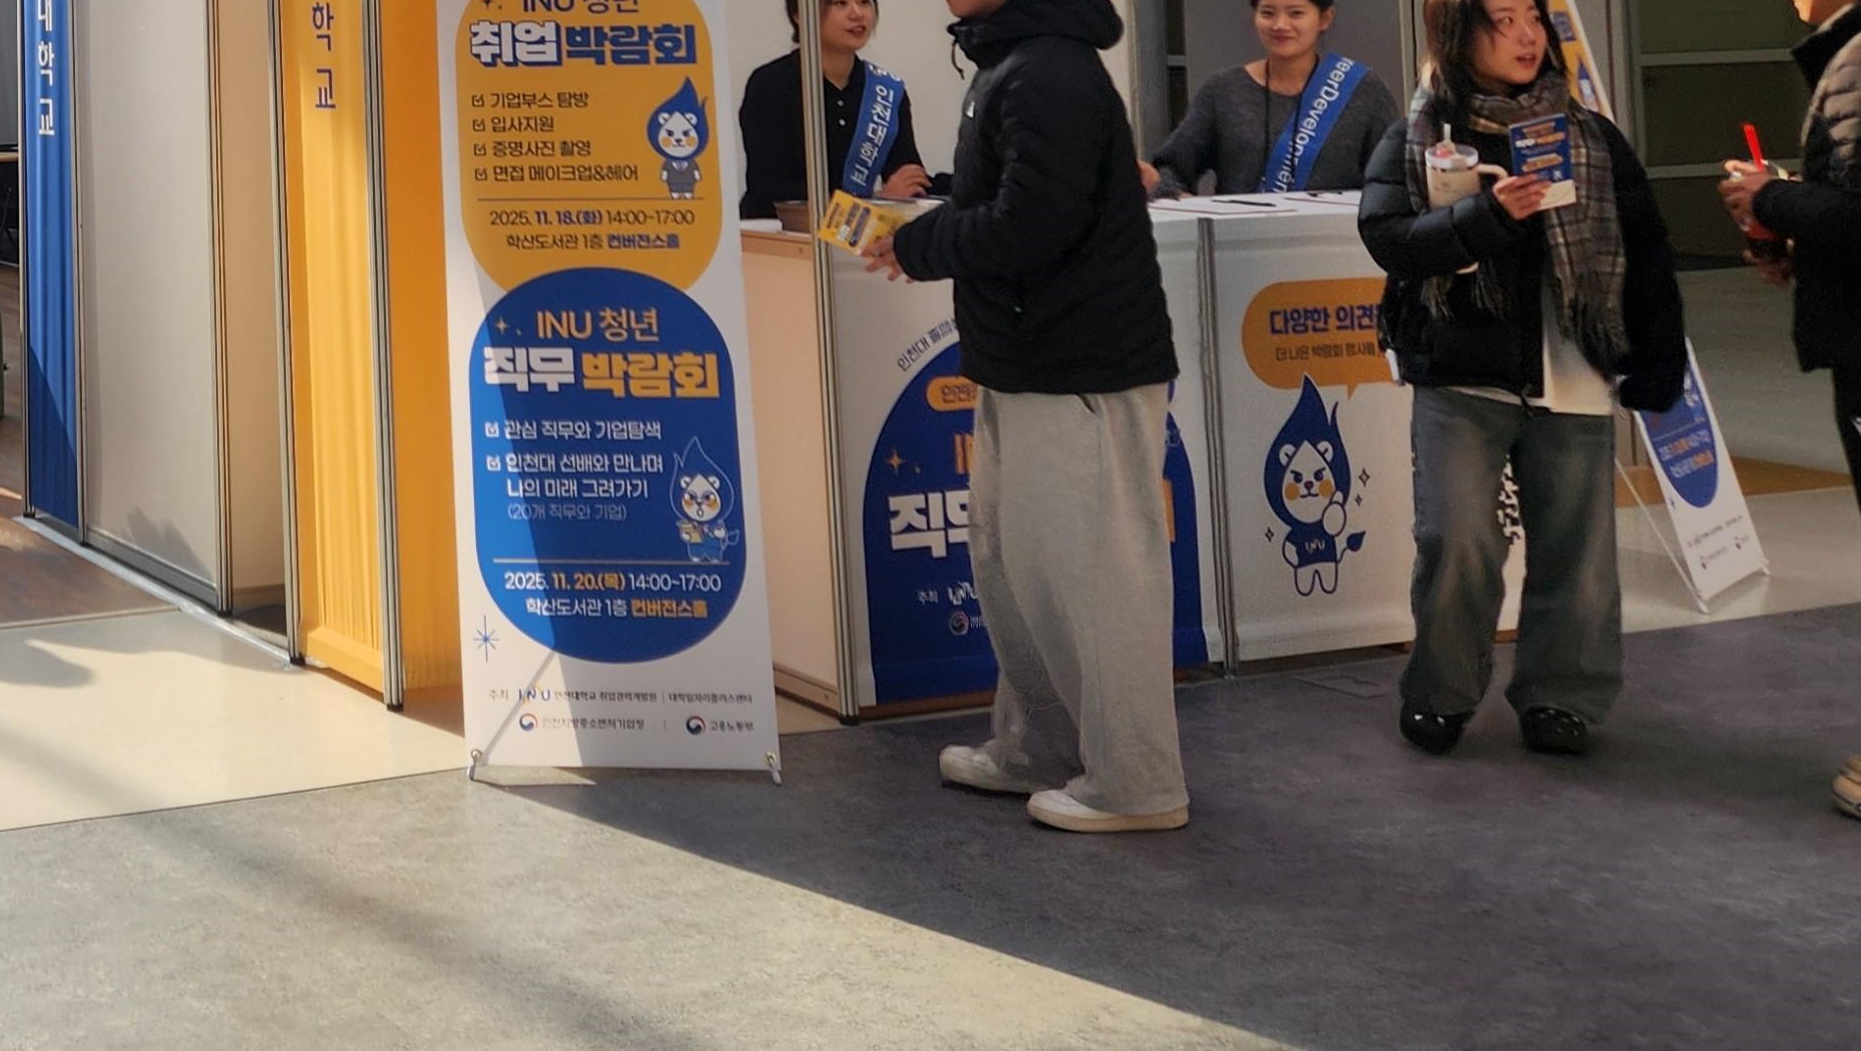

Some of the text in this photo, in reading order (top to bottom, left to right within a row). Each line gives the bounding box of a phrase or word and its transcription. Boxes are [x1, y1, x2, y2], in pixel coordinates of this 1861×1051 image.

[469, 20, 698, 68] 취업 박람회
[490, 92, 589, 109] 기업부스 탐방
[491, 116, 554, 133] 입사지원
[850, 85, 894, 187] 인천대학교
[492, 140, 556, 157] 증명사진
[493, 165, 525, 182] 면접
[507, 233, 578, 250] 학산도서관
[537, 307, 659, 341] INU 청년
[1269, 304, 1380, 335] 다양한 의견
[484, 346, 720, 399] 직무 박람회
[505, 420, 661, 439] 관심 직무와 기업탐색
[505, 453, 663, 474] 인천대 선배와 만나며
[506, 479, 648, 499] 나의 미래 그려가기
[526, 598, 602, 617] 학산도서관
